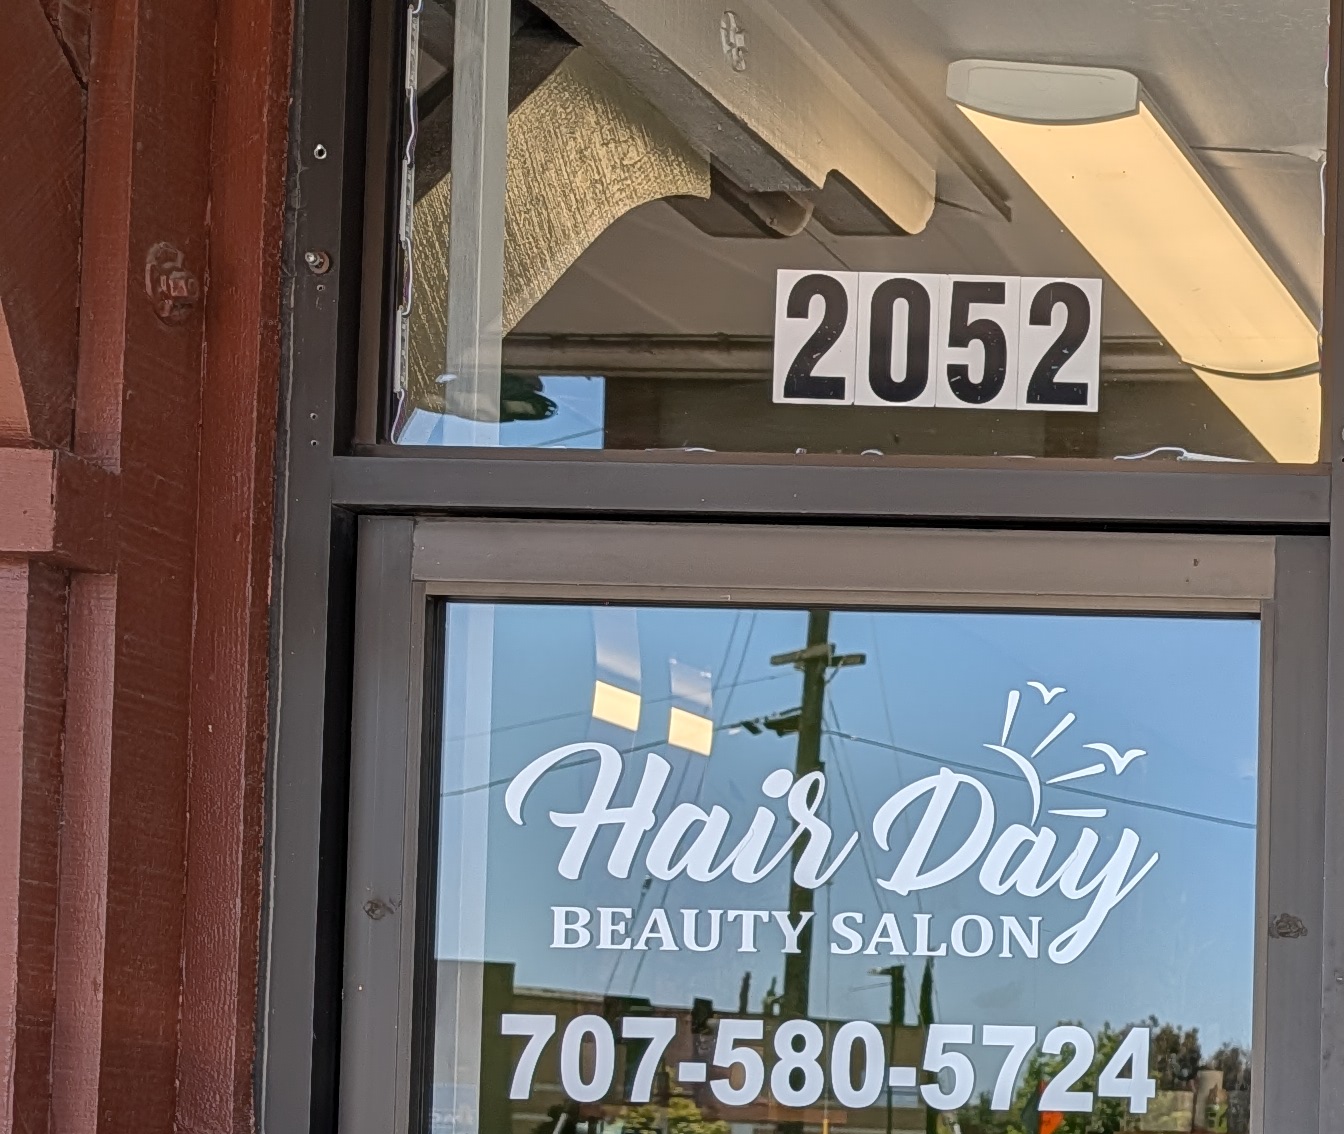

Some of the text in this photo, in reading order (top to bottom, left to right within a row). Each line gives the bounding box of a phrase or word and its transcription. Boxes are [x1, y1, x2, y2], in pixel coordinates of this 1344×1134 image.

[783, 273, 1091, 407] 2052
[504, 742, 1160, 964] Hair Day
[549, 906, 1044, 959] BEAUTY SALON
[500, 1012, 1157, 1115] 707-580-5724
